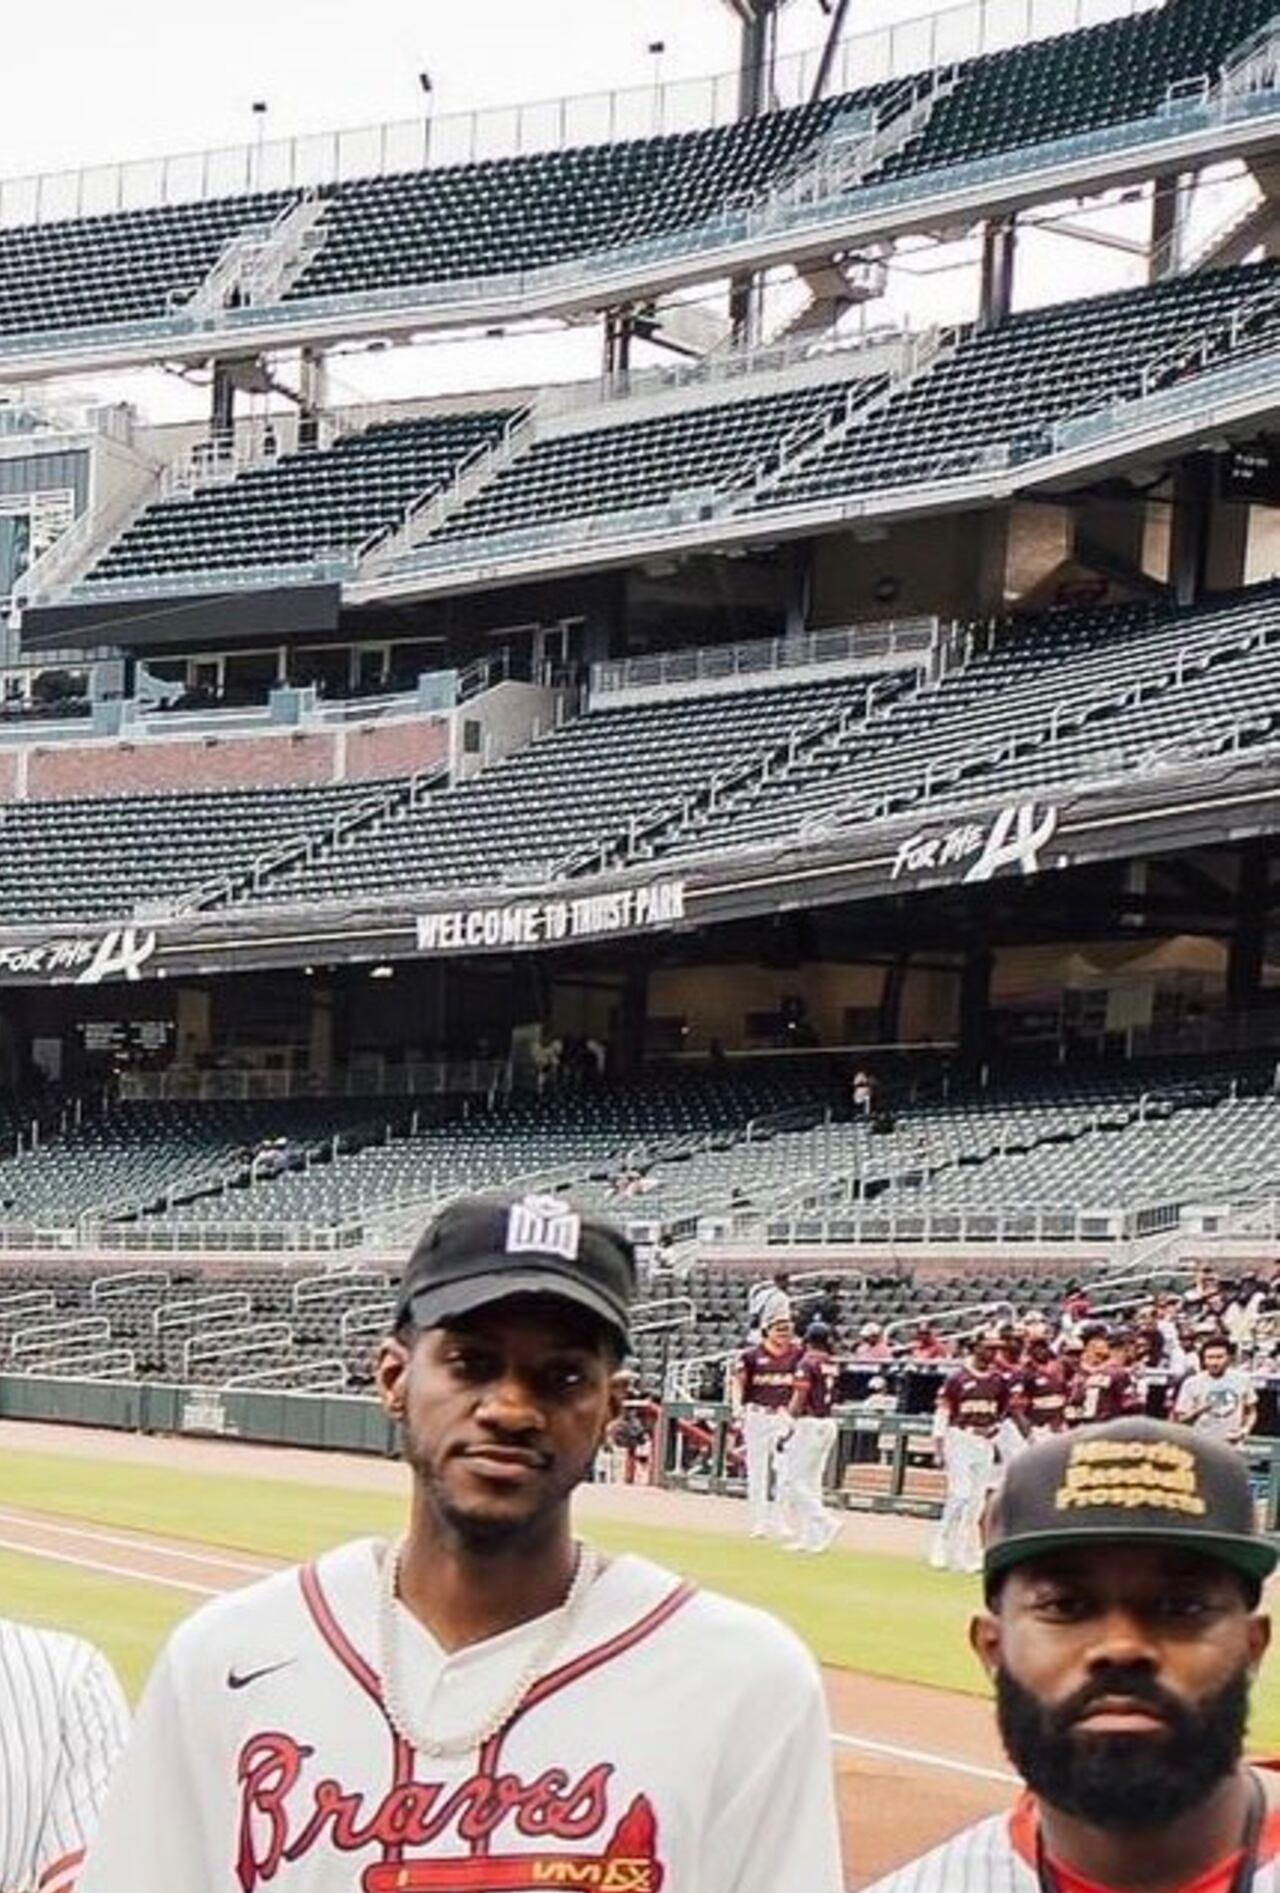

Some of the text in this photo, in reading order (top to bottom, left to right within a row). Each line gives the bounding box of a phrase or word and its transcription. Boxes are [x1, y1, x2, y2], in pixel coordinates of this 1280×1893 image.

[891, 835, 941, 880] FOR
[416, 880, 685, 950] WELCOME TO TRUIST PARK
